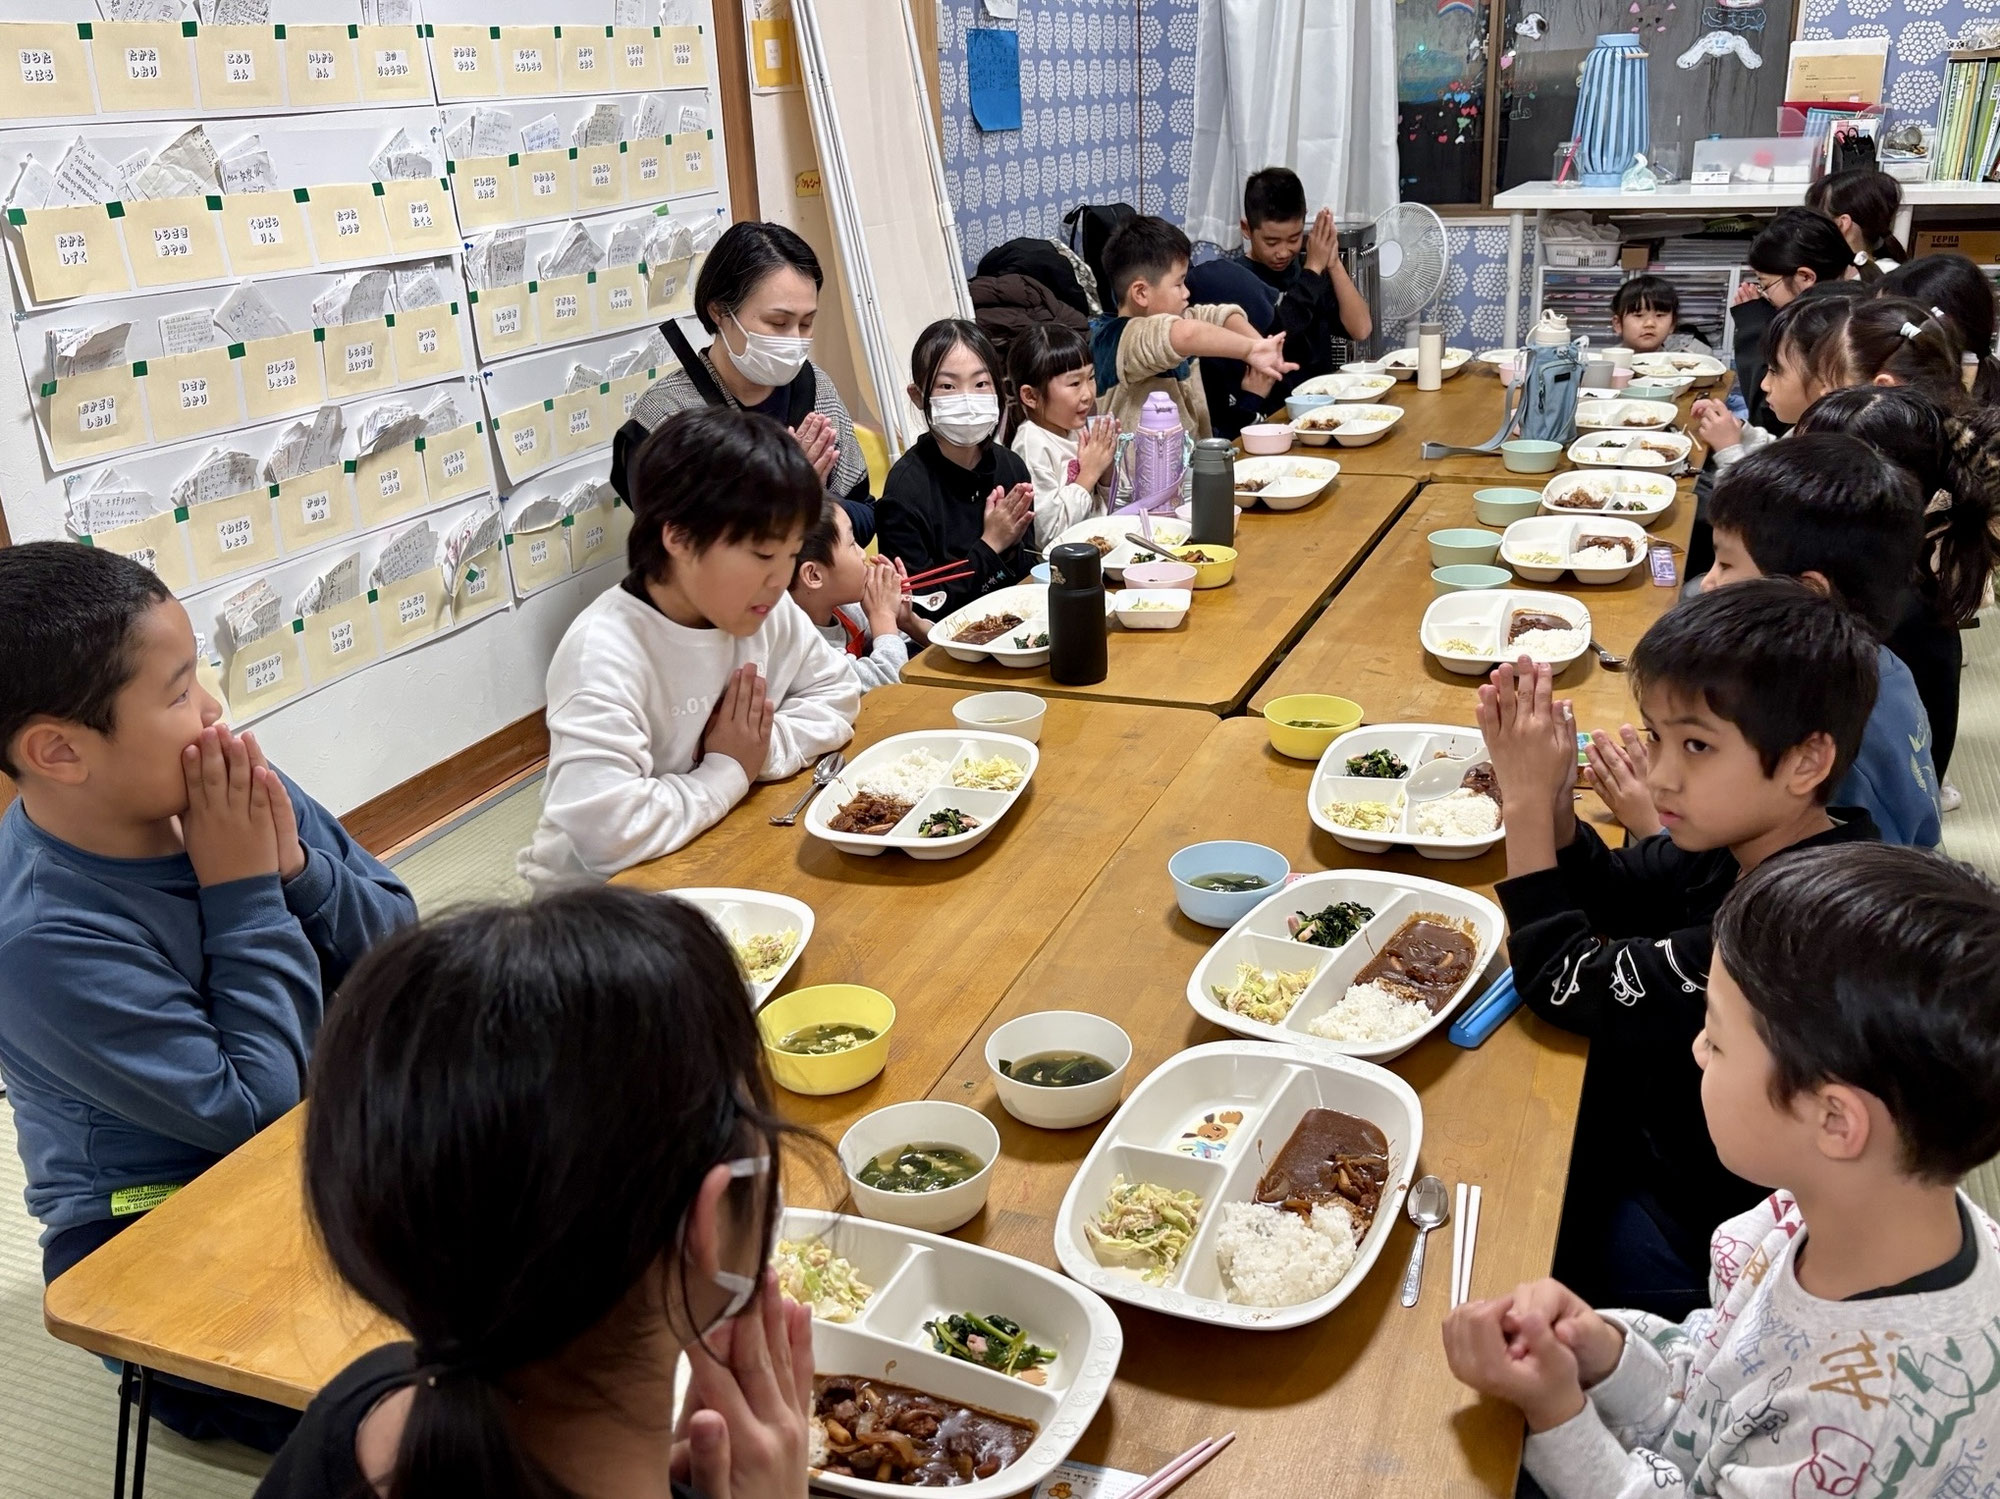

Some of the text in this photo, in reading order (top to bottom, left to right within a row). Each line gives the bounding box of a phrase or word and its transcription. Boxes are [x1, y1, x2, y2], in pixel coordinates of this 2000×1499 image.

[129, 49, 156, 61] たかた
[132, 66, 157, 78] しおり
[250, 217, 279, 230] くわばら
[58, 235, 85, 248] たかた
[62, 251, 87, 264] しずく
[87, 413, 111, 429] しおり
[114, 1204, 131, 1213] NEW
